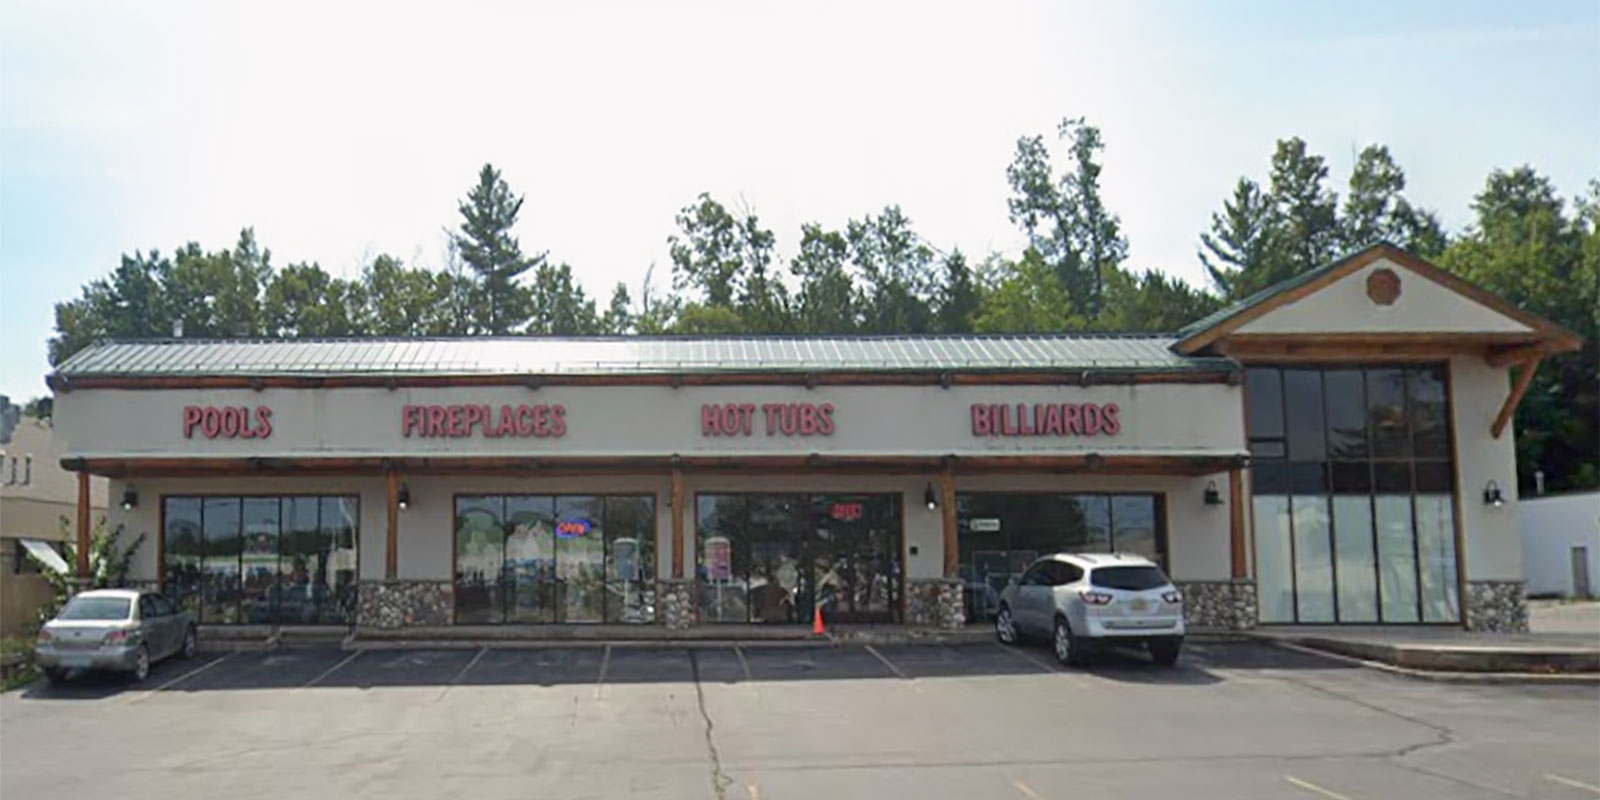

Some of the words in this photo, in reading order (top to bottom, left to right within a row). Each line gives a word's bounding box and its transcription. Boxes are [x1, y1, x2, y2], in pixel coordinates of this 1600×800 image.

[183, 406, 272, 439] POOLS
[402, 404, 566, 438] FIREPLACES
[701, 403, 756, 436] HOT
[763, 403, 835, 436] TUBS
[971, 403, 1121, 436] BILLIARDS
